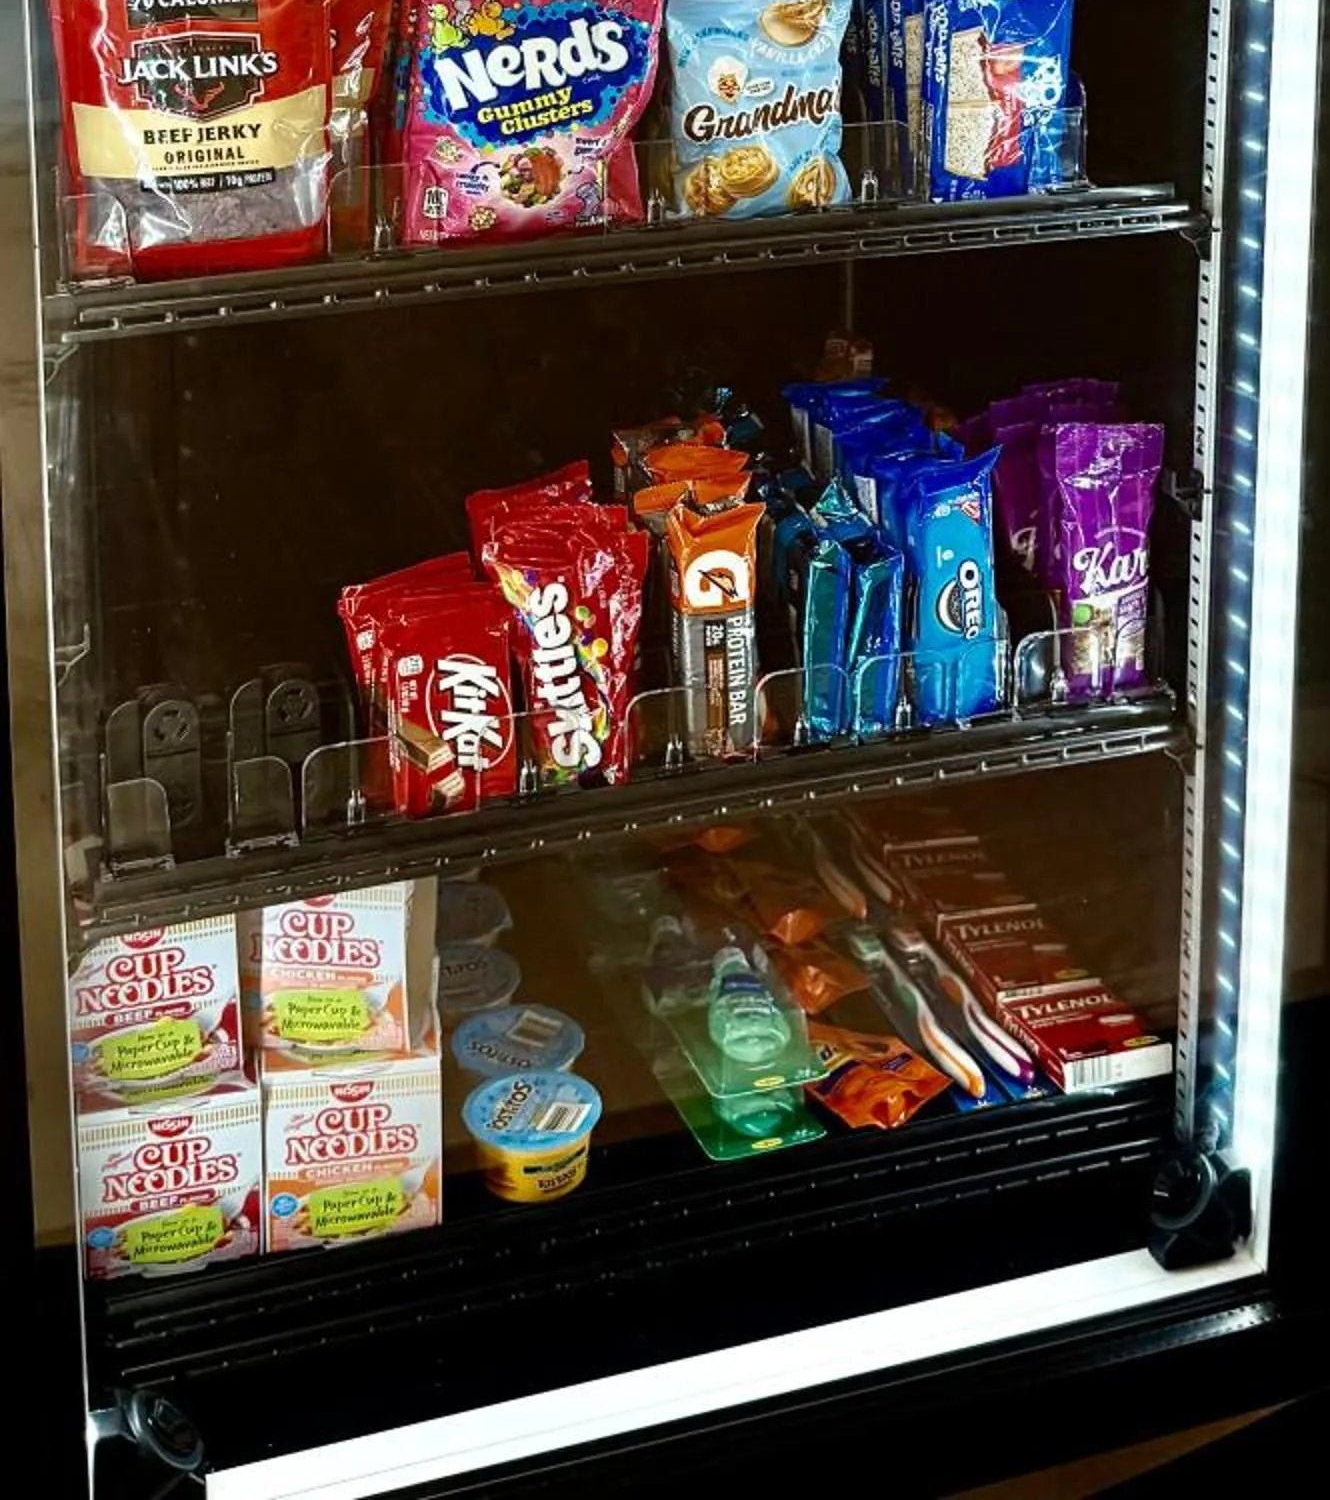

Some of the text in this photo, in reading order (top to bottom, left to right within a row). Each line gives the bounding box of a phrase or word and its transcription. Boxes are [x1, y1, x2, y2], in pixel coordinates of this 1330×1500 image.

[118, 51, 278, 84] JACK LINK'S
[477, 86, 574, 125] Gummy
[501, 97, 593, 135] Clusters
[143, 123, 262, 145] BEEF JERKY
[164, 145, 245, 164] ORIGINAL
[958, 560, 983, 640] OREO
[528, 583, 602, 768] Skittles
[727, 615, 747, 725] PROTEIN BAR
[281, 909, 355, 939] CUP
[955, 917, 1044, 941] TYLENOL
[106, 946, 185, 983] CUP
[272, 967, 337, 981] CHICKEN
[77, 964, 214, 1016] NOODLES
[114, 1008, 150, 1024] BEEF
[288, 1002, 320, 1018] Paper
[323, 1003, 349, 1017] Cup
[1014, 993, 1114, 1019] TYLENOL
[281, 1017, 362, 1032] Microwavable
[110, 1047, 194, 1074] Microwavable
[117, 1042, 152, 1059] Paper
[155, 1039, 181, 1054] Cup
[316, 1103, 392, 1136] CUP
[133, 1136, 212, 1172] CUP
[286, 1123, 417, 1165] NOODLES
[102, 1154, 238, 1202] NOODLES
[305, 1162, 373, 1178] CHICKEN
[139, 1195, 178, 1212] BEEF
[315, 1204, 396, 1228] Microwavable
[323, 1198, 356, 1213] Paper
[358, 1196, 383, 1210] Cup
[133, 1235, 216, 1257] Microwavable
[141, 1229, 175, 1242] Paper
[178, 1226, 204, 1240] Cup
